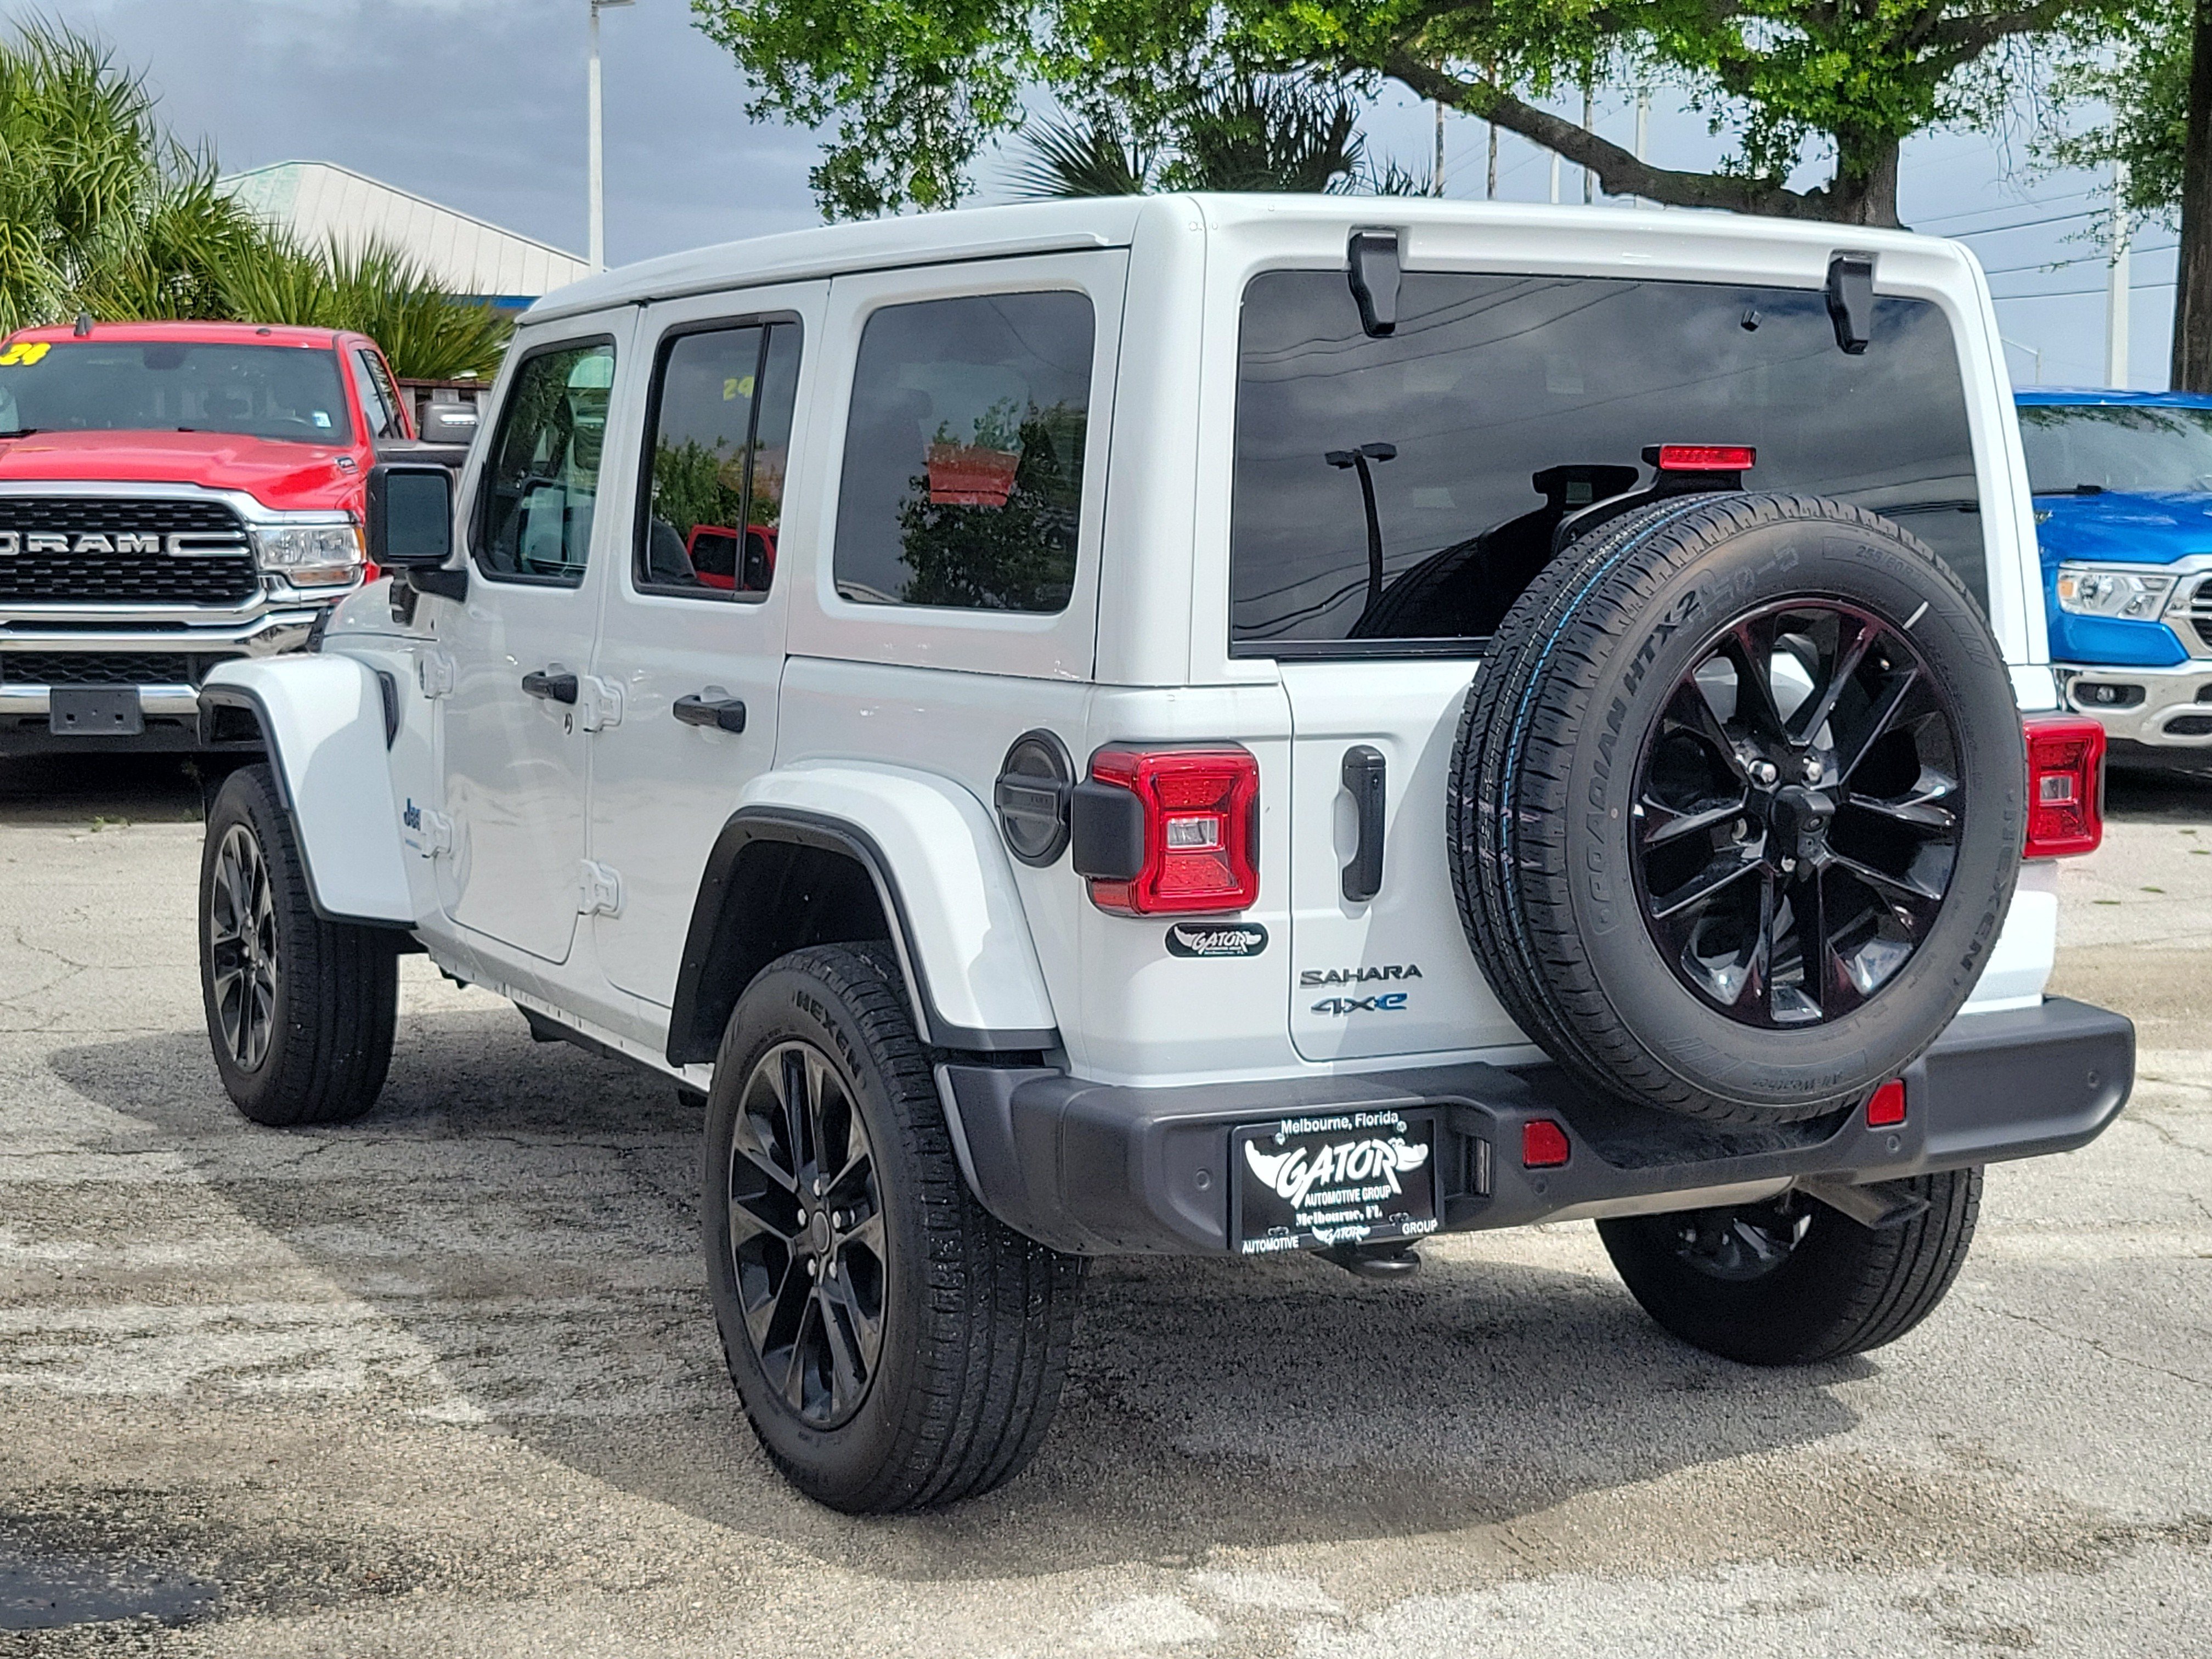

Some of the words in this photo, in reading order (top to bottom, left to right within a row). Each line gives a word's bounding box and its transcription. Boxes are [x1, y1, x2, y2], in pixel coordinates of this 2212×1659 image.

[28, 532, 160, 554] RAM
[1623, 590, 1700, 697] HTX2
[1192, 931, 1248, 955] GATOR
[1300, 964, 1423, 985] SAHARA
[797, 990, 861, 1080] NEXEN
[1281, 1117, 1352, 1135] Melbourne,
[1355, 1110, 1398, 1128] Florida
[1276, 1139, 1402, 1209] GATOR
[1305, 1188, 1361, 1207] AUTOMOTIVE
[1362, 1184, 1391, 1201] GROUP
[1296, 1210, 1364, 1227] Melbourne,
[1242, 1236, 1299, 1254] AUTOMOTIVE
[1324, 1226, 1362, 1246] GATOR
[1402, 1218, 1438, 1235] GROUP
